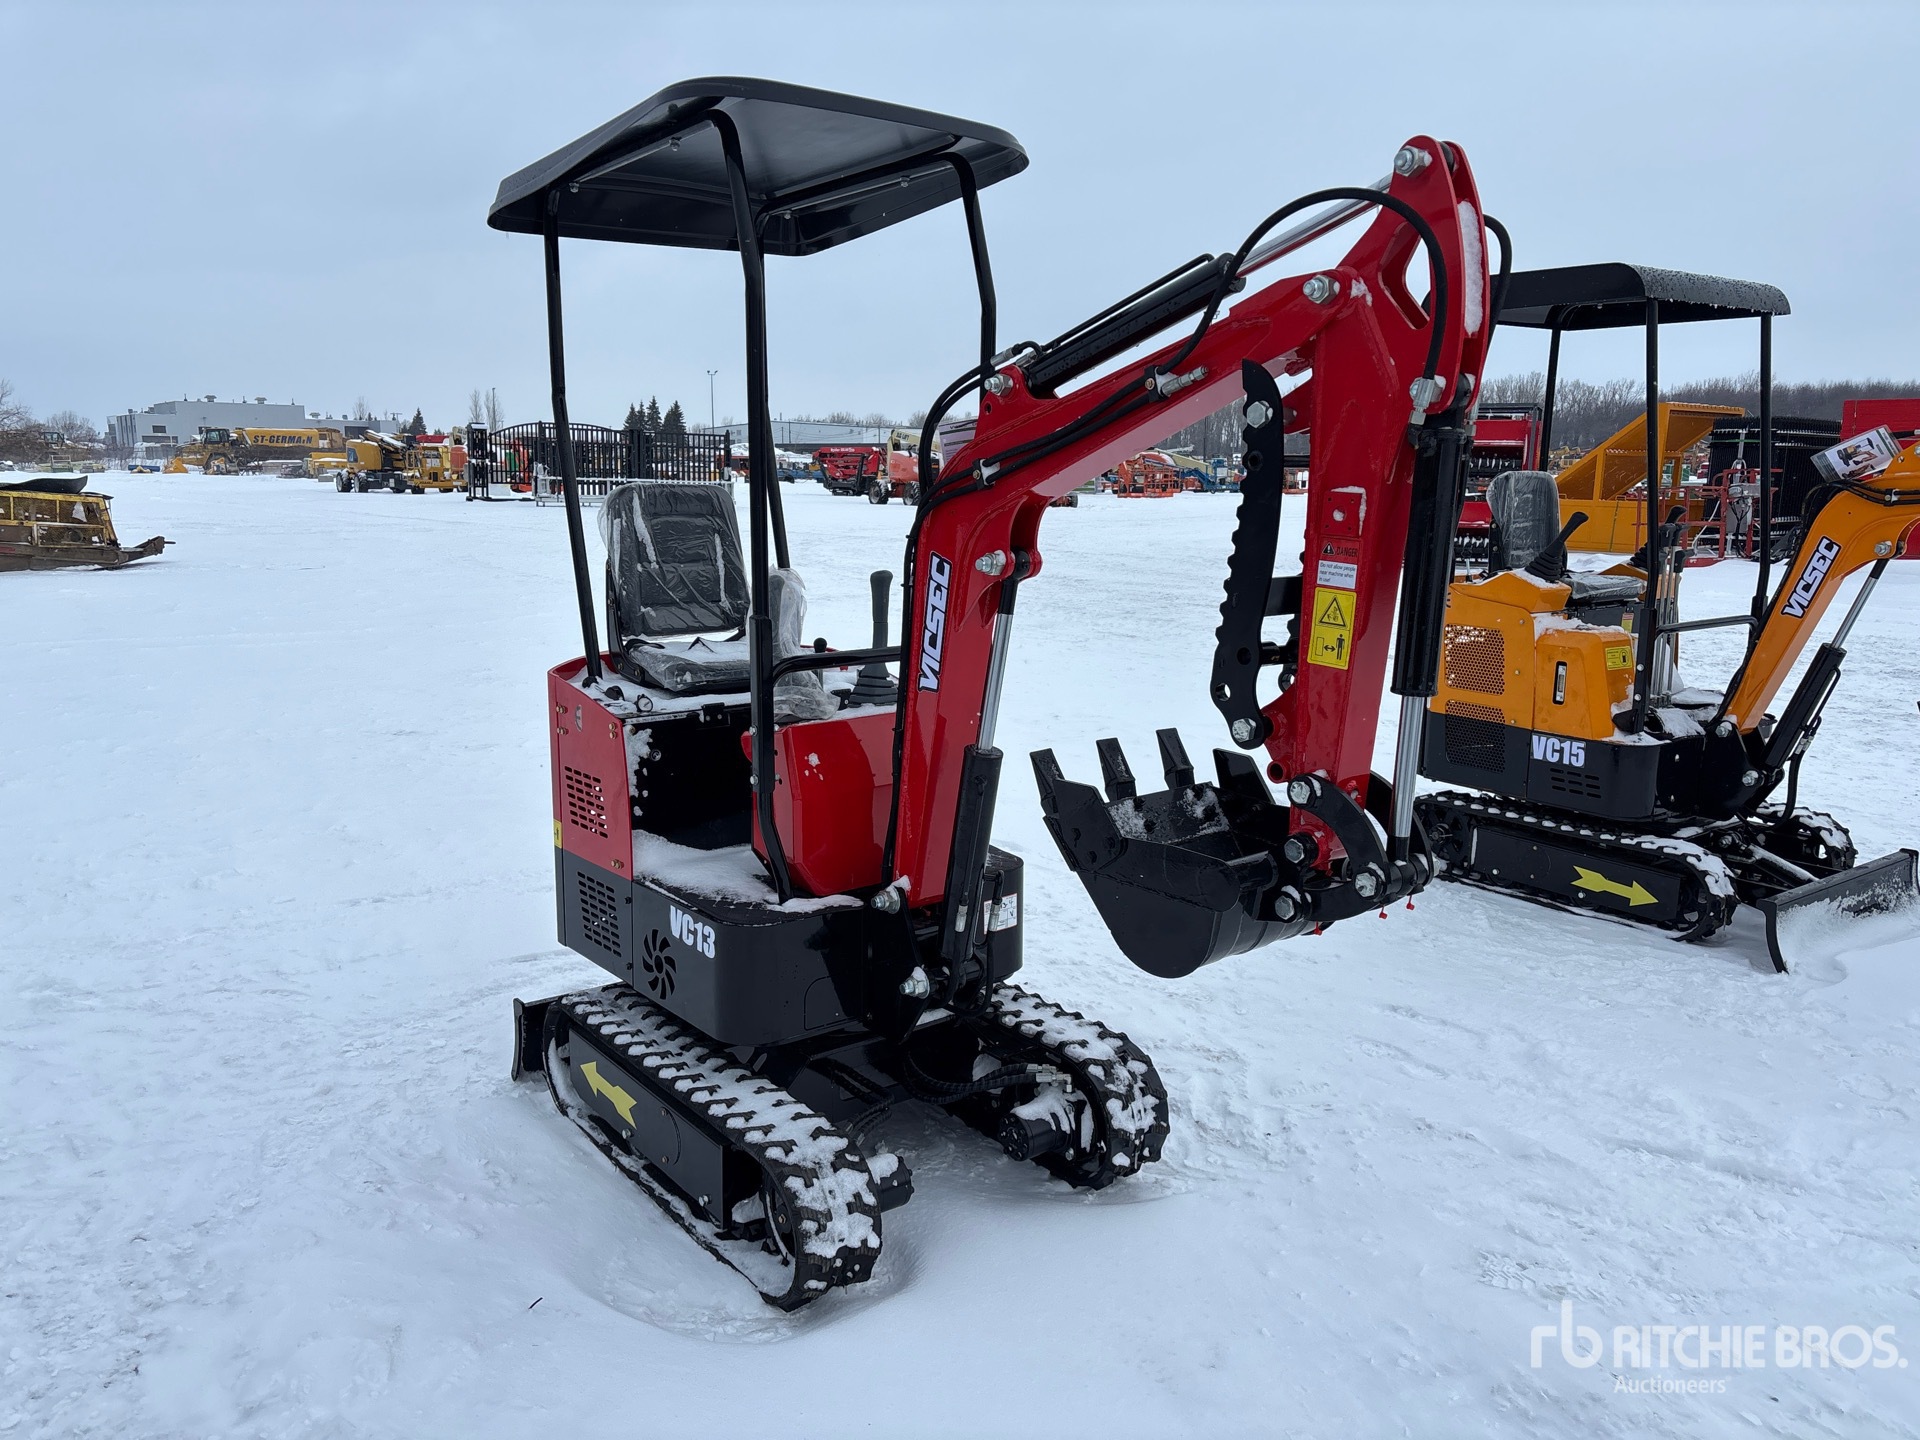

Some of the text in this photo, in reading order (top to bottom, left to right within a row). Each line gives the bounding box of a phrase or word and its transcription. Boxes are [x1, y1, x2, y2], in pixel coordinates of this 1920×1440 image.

[1336, 546, 1358, 558] DANGER
[1781, 536, 1841, 618] VICSEC
[918, 551, 952, 692] VICSEC
[1532, 735, 1586, 767] VC15
[670, 905, 715, 959] VC13
